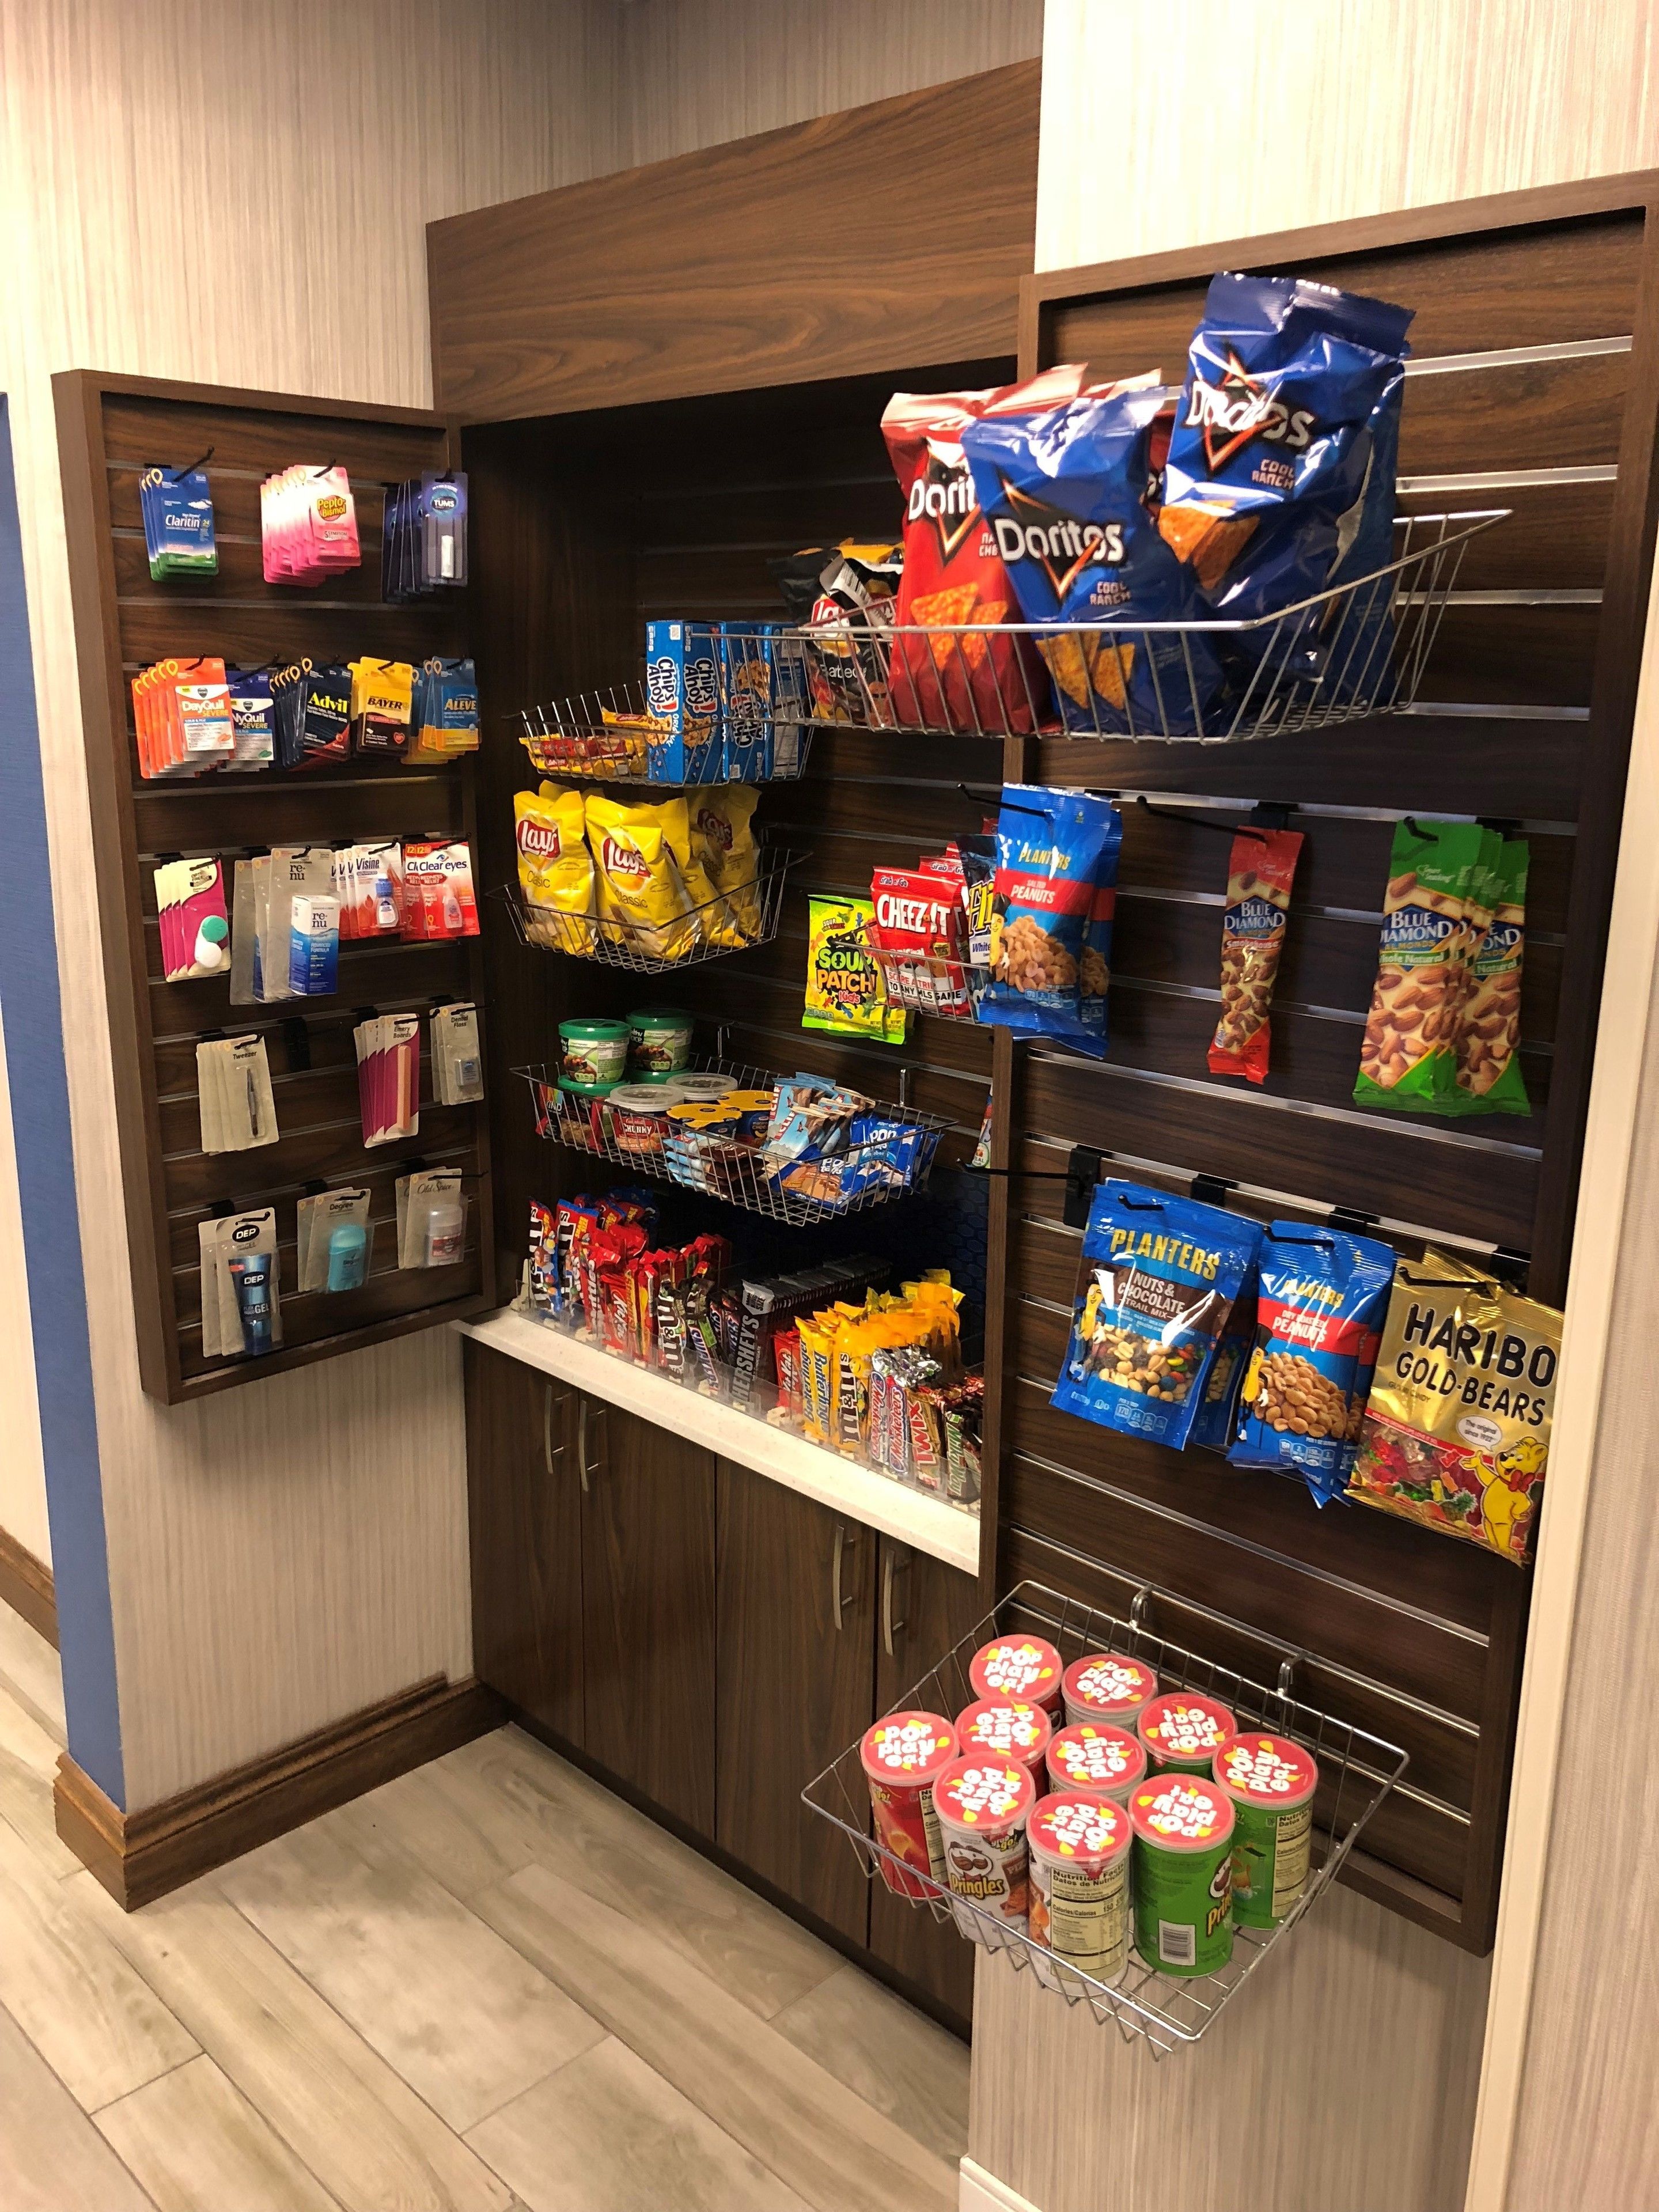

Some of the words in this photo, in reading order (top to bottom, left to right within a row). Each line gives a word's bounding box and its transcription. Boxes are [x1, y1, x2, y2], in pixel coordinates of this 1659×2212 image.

[1260, 459, 1296, 478] COOL
[1252, 470, 1294, 490] RANCH
[434, 499, 454, 507] TUMS
[908, 475, 976, 520] Dorit
[166, 514, 200, 528] Claritin
[323, 505, 346, 517] Bismol
[995, 519, 1124, 562] Doritos
[657, 657, 675, 702] Chips
[695, 658, 713, 702] Chips
[181, 699, 225, 714] DayQuil
[308, 692, 348, 713] Advil
[368, 696, 402, 709] BAYER
[444, 698, 476, 710] ALEVE
[666, 714, 679, 747] ORIGNAL
[521, 821, 558, 856] Lay's
[357, 858, 379, 870] Visine
[419, 862, 442, 872] Clear
[445, 861, 467, 872] eyes
[607, 840, 646, 873] Lay's
[1018, 849, 1071, 870] PLANTRS
[616, 891, 649, 908] Classic
[1010, 885, 1055, 904] PEANUTS
[969, 881, 994, 935] Fli
[1241, 902, 1271, 916] BLUE
[1224, 912, 1286, 930] DIAMOND
[1391, 911, 1432, 929] BLUE
[1380, 921, 1453, 943] IAMOND
[972, 941, 991, 952] White
[816, 969, 876, 993] PATCH
[889, 982, 898, 991] TO
[935, 990, 961, 1001] GAME
[838, 991, 861, 1004] Kids
[394, 1026, 411, 1034] Emery
[233, 1050, 257, 1060] Tweezer
[329, 1202, 354, 1210] Degree
[236, 1228, 256, 1240] DEP
[1110, 1229, 1220, 1281] PLANTERS
[244, 1274, 264, 1285] DEP
[1134, 1272, 1165, 1294] NUTS
[1165, 1283, 1175, 1297] &
[1118, 1282, 1185, 1314] CHOCOLATE
[1125, 1298, 1149, 1313] TRAIL
[1151, 1308, 1168, 1319] MIX
[255, 1305, 269, 1315] GEL
[1272, 1317, 1328, 1343] PEANUTS
[1403, 1302, 1556, 1388] HARIBO
[732, 1315, 760, 1402] HERSHEY'S
[813, 1350, 830, 1433] Butterfinge
[1396, 1351, 1546, 1426] GOLD-BEARS
[891, 1387, 903, 1465] Musketeers
[1466, 1419, 1475, 1427] The
[1477, 1425, 1497, 1434] original
[984, 1661, 1040, 1683] play
[1078, 1667, 1132, 1700] play
[988, 1707, 1014, 1749] play
[1159, 1716, 1218, 1737] play
[878, 1738, 935, 1759] play
[1084, 1737, 1114, 1778] play
[1247, 1750, 1281, 1793] play
[961, 1766, 1003, 1812] play
[1152, 1794, 1217, 1826] play
[1056, 1803, 1097, 1846] play
[1053, 1869, 1099, 1881] Nutritio
[1053, 1875, 1077, 1886] Datos
[1080, 1879, 1091, 1887] de
[951, 1873, 1005, 1900] Pringles
